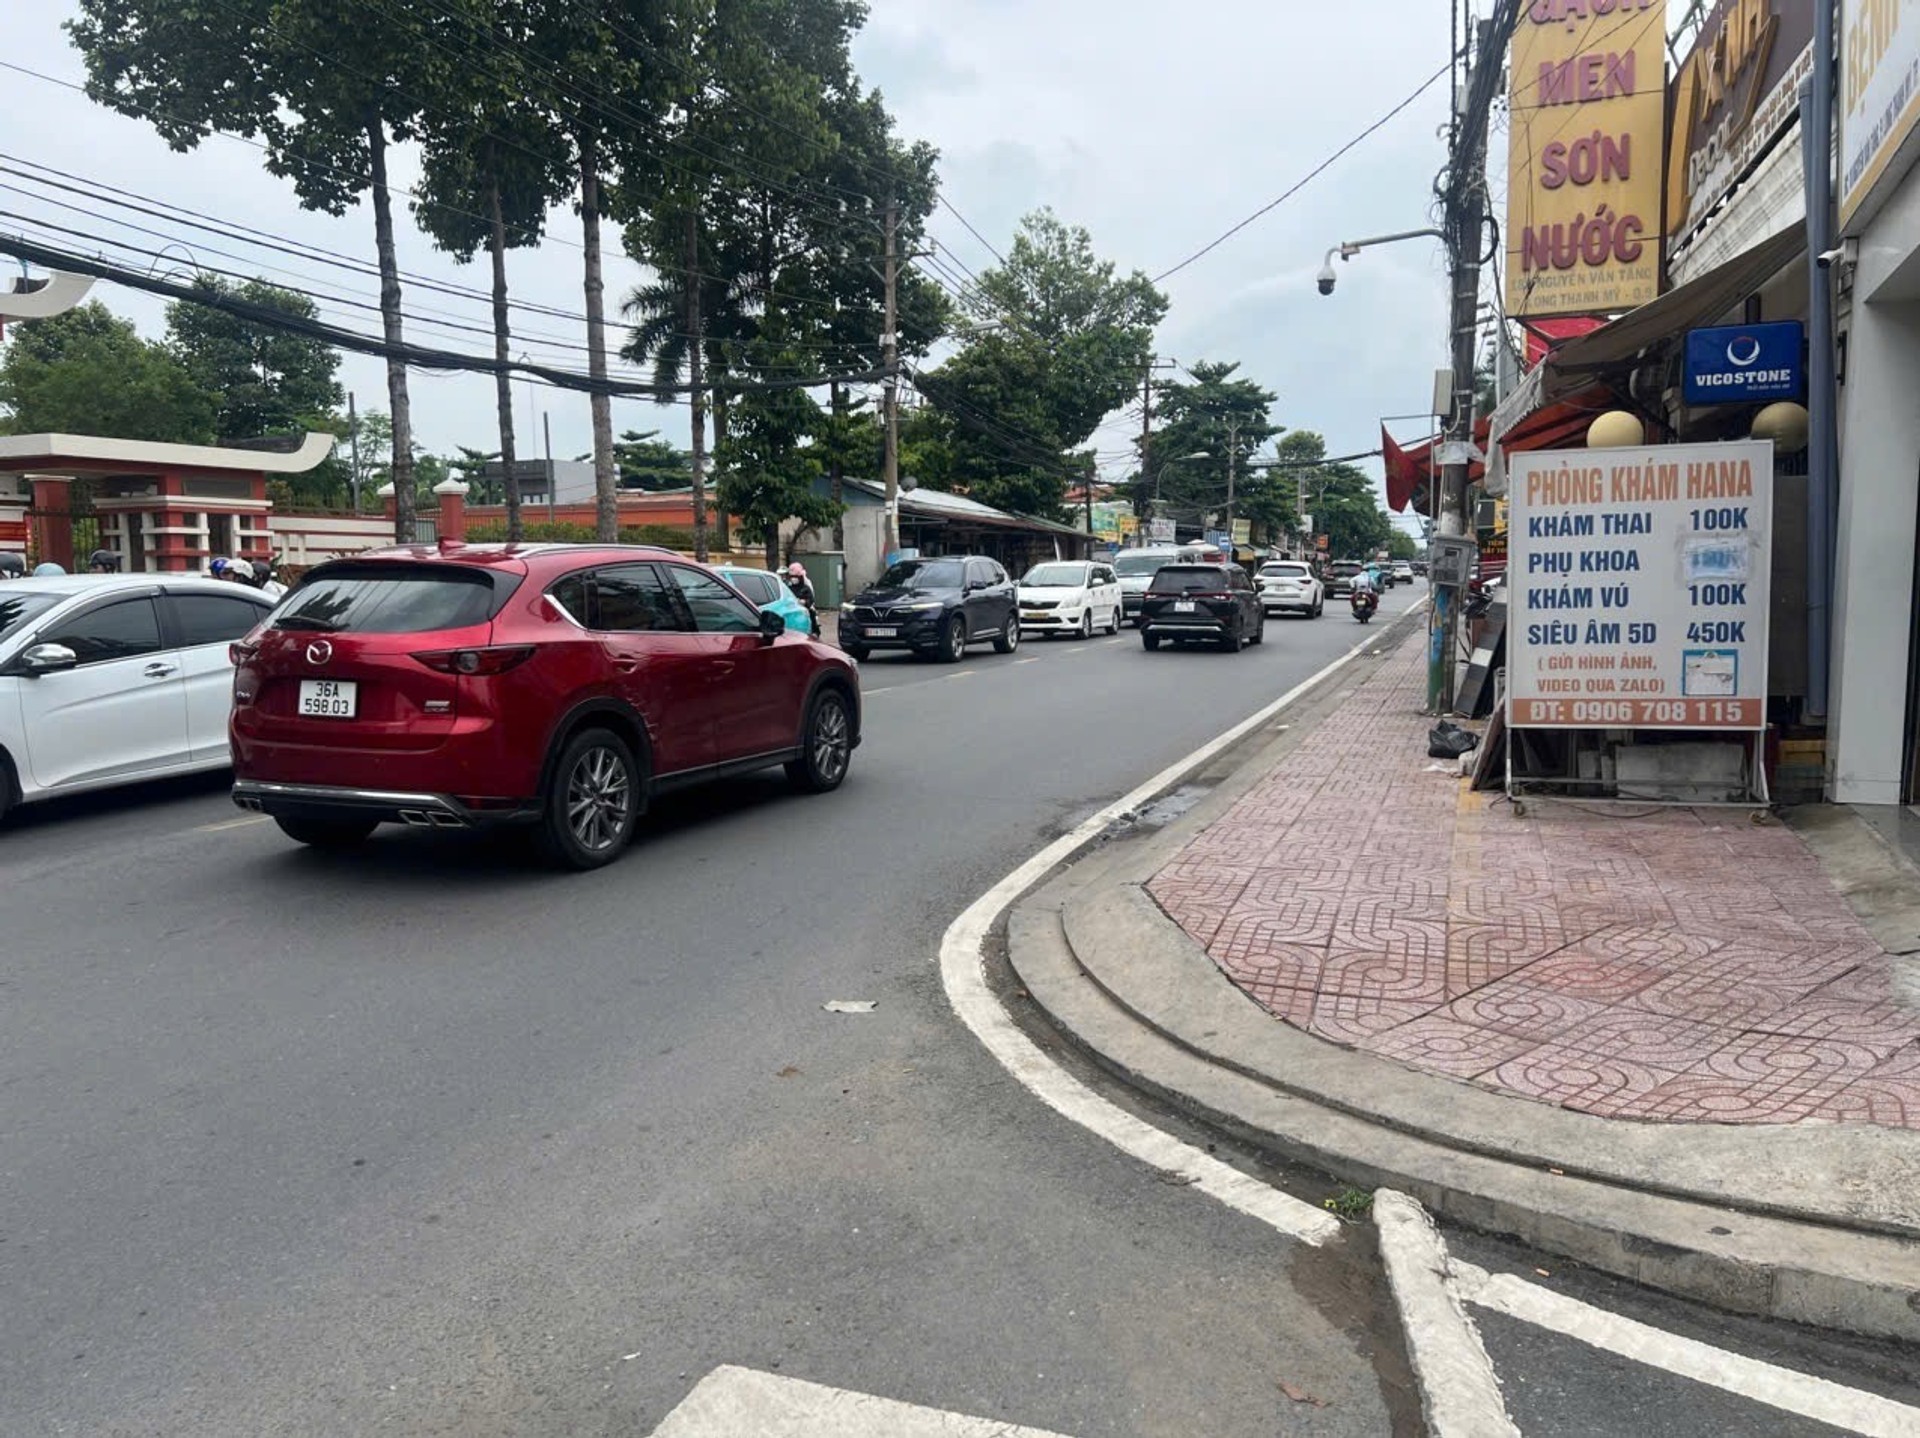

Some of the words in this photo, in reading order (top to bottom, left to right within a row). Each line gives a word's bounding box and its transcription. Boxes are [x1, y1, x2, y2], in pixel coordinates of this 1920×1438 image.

[1538, 48, 1636, 108] MEN
[1540, 129, 1631, 190] SƠN
[1521, 203, 1644, 273] NƯỚC
[1695, 369, 1791, 387] VICOSTONE
[1527, 461, 1604, 506] PHÒNG
[1611, 458, 1679, 502] KHÁM
[1686, 460, 1753, 500] HANA
[1528, 511, 1595, 538] KHÁM
[1602, 512, 1652, 535] THAI
[1690, 507, 1749, 531] 100K
[1529, 552, 1573, 578] PHỤ
[1580, 550, 1641, 573] KHOA
[1528, 583, 1593, 609] KHÁM
[1601, 582, 1630, 608] VÚ
[1688, 584, 1747, 606] 100K
[1527, 619, 1578, 646] SIÊU
[1585, 619, 1621, 644] ÂM
[1628, 623, 1657, 644] 5D
[1687, 621, 1746, 643] 450K
[316, 683, 339, 698] 36A
[1537, 679, 1581, 692] VIDEO
[1585, 679, 1616, 693] QUA
[1620, 679, 1665, 693] ZALO)
[304, 698, 349, 715] 598.03
[1572, 701, 1633, 722] 0906
[1641, 701, 1687, 722] 708
[1696, 701, 1742, 722] 115
